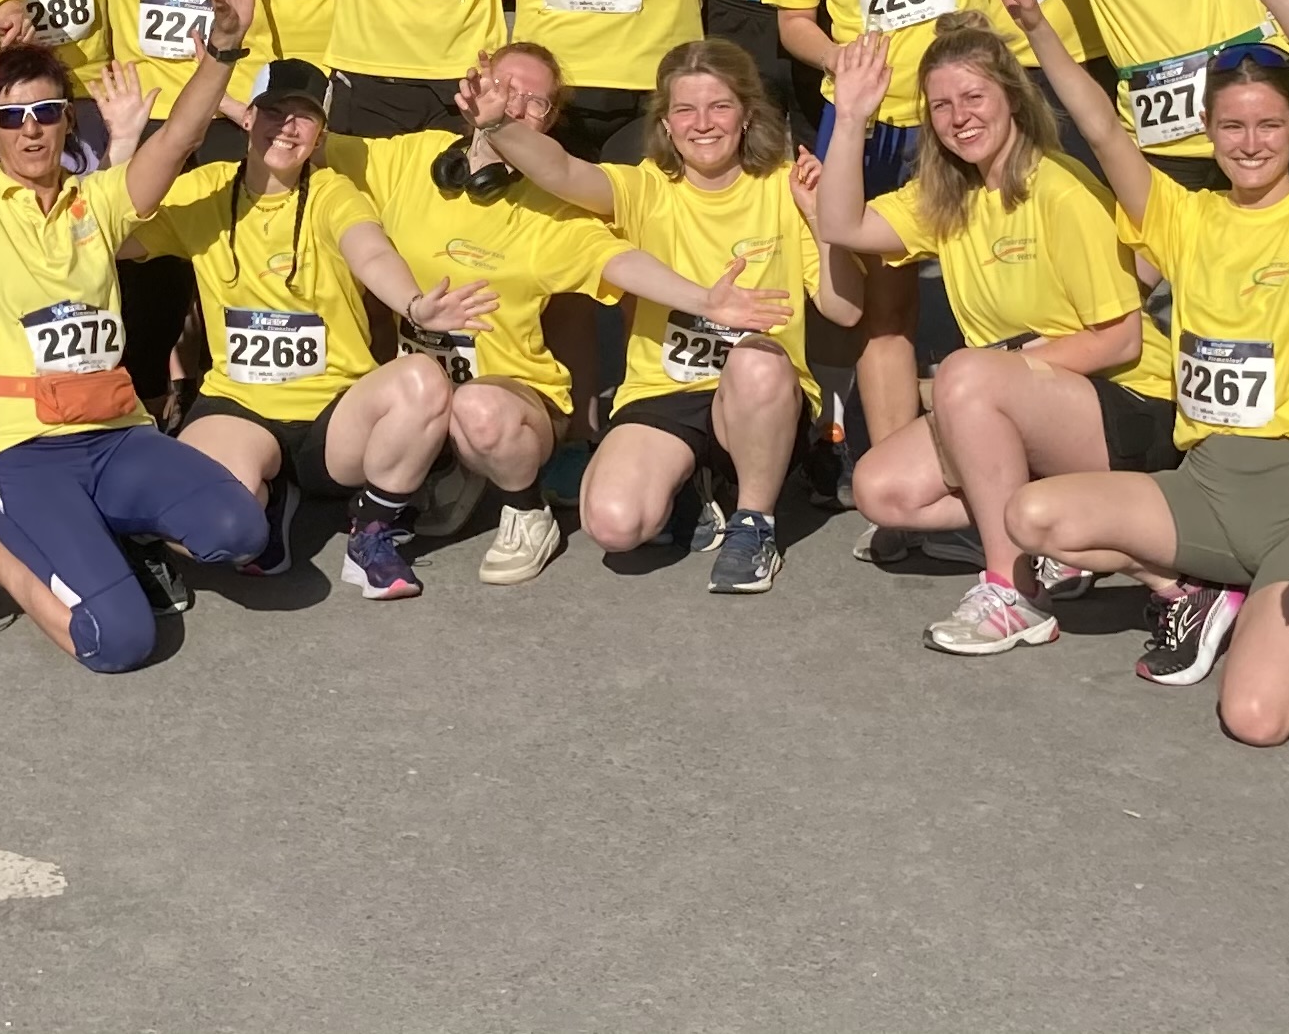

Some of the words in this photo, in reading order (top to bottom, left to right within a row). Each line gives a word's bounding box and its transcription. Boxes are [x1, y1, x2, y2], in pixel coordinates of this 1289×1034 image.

[145, 9, 208, 44] 224
[1136, 83, 1196, 129] 227
[38, 318, 120, 363] 2272
[230, 333, 319, 368] 2268
[668, 331, 734, 367] 225
[1181, 360, 1268, 408] 2267
